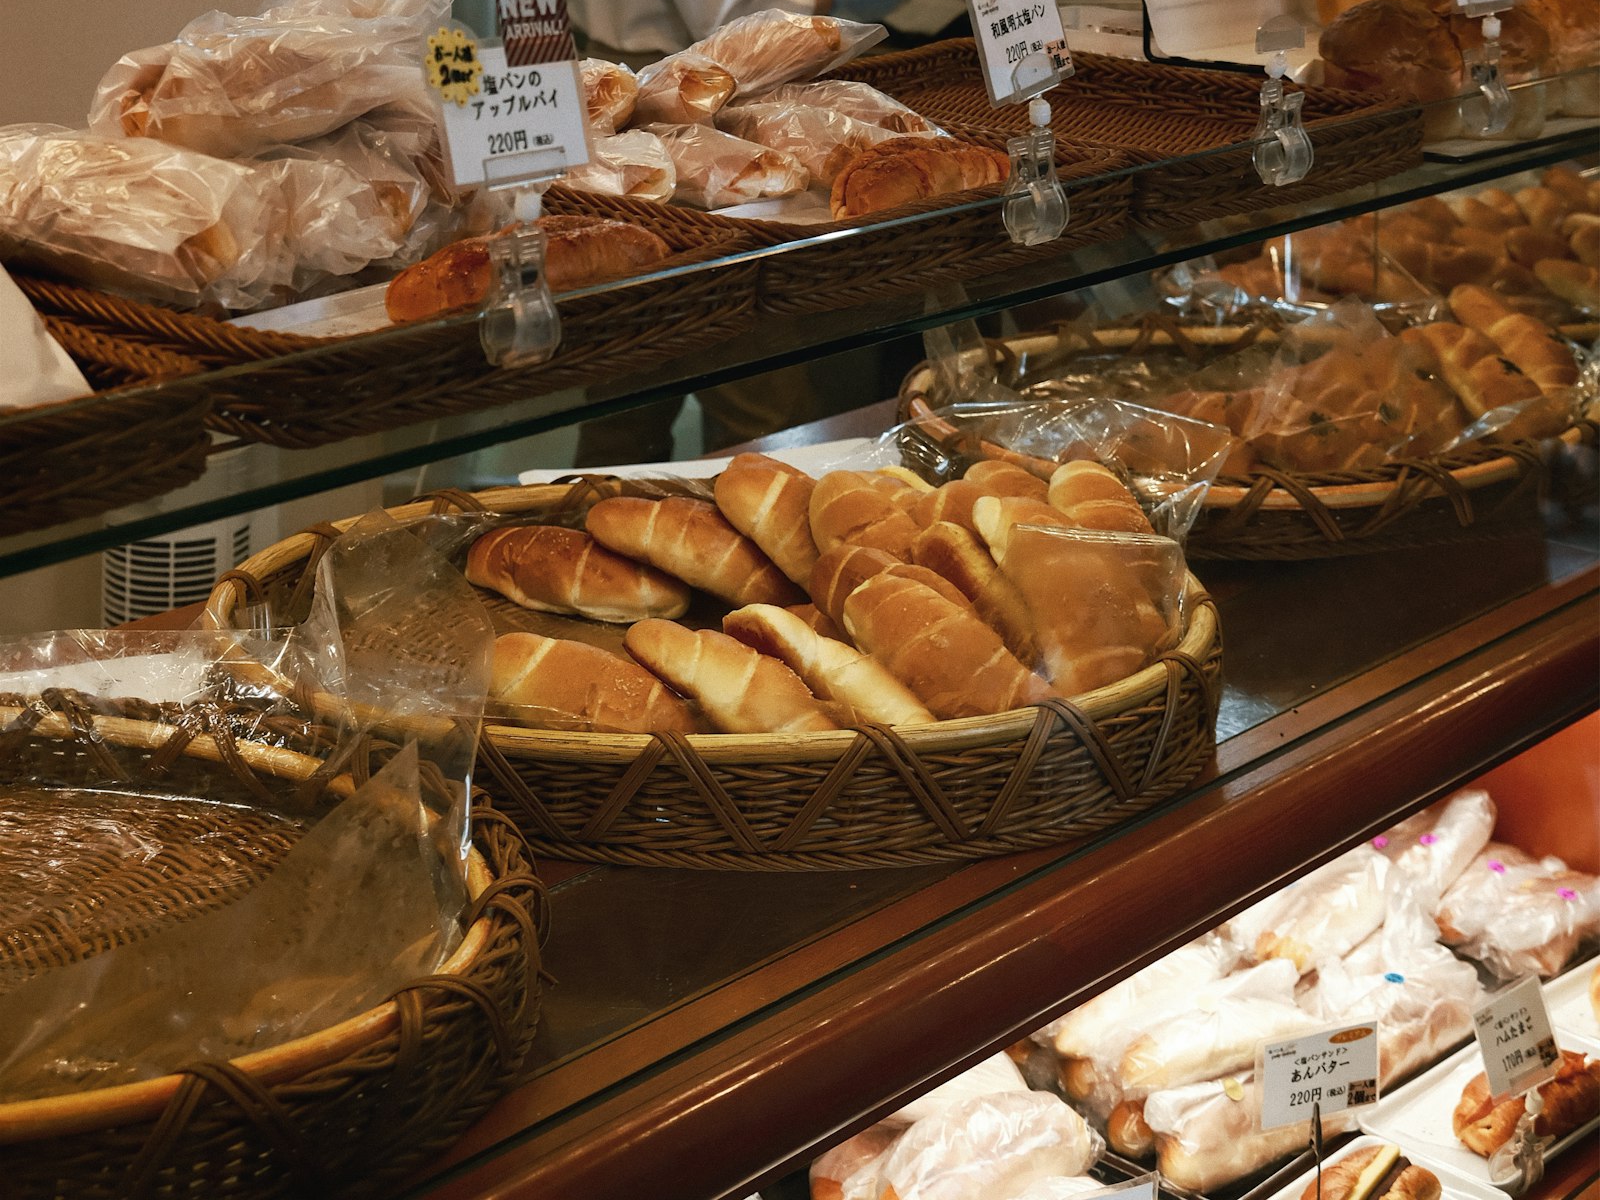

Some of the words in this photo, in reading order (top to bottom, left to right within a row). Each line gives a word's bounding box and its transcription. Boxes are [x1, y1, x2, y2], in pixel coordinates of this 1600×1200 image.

[506, 20, 564, 41] ARRIVAL!
[990, 4, 1045, 39] 和風明太塩パン
[1006, 40, 1029, 64] 220円
[483, 70, 541, 95] 塩パンの
[472, 89, 558, 120] アップルパイ
[488, 129, 528, 154] 220円
[1291, 1060, 1350, 1083] あんバター
[1290, 1087, 1322, 1107] 220円
